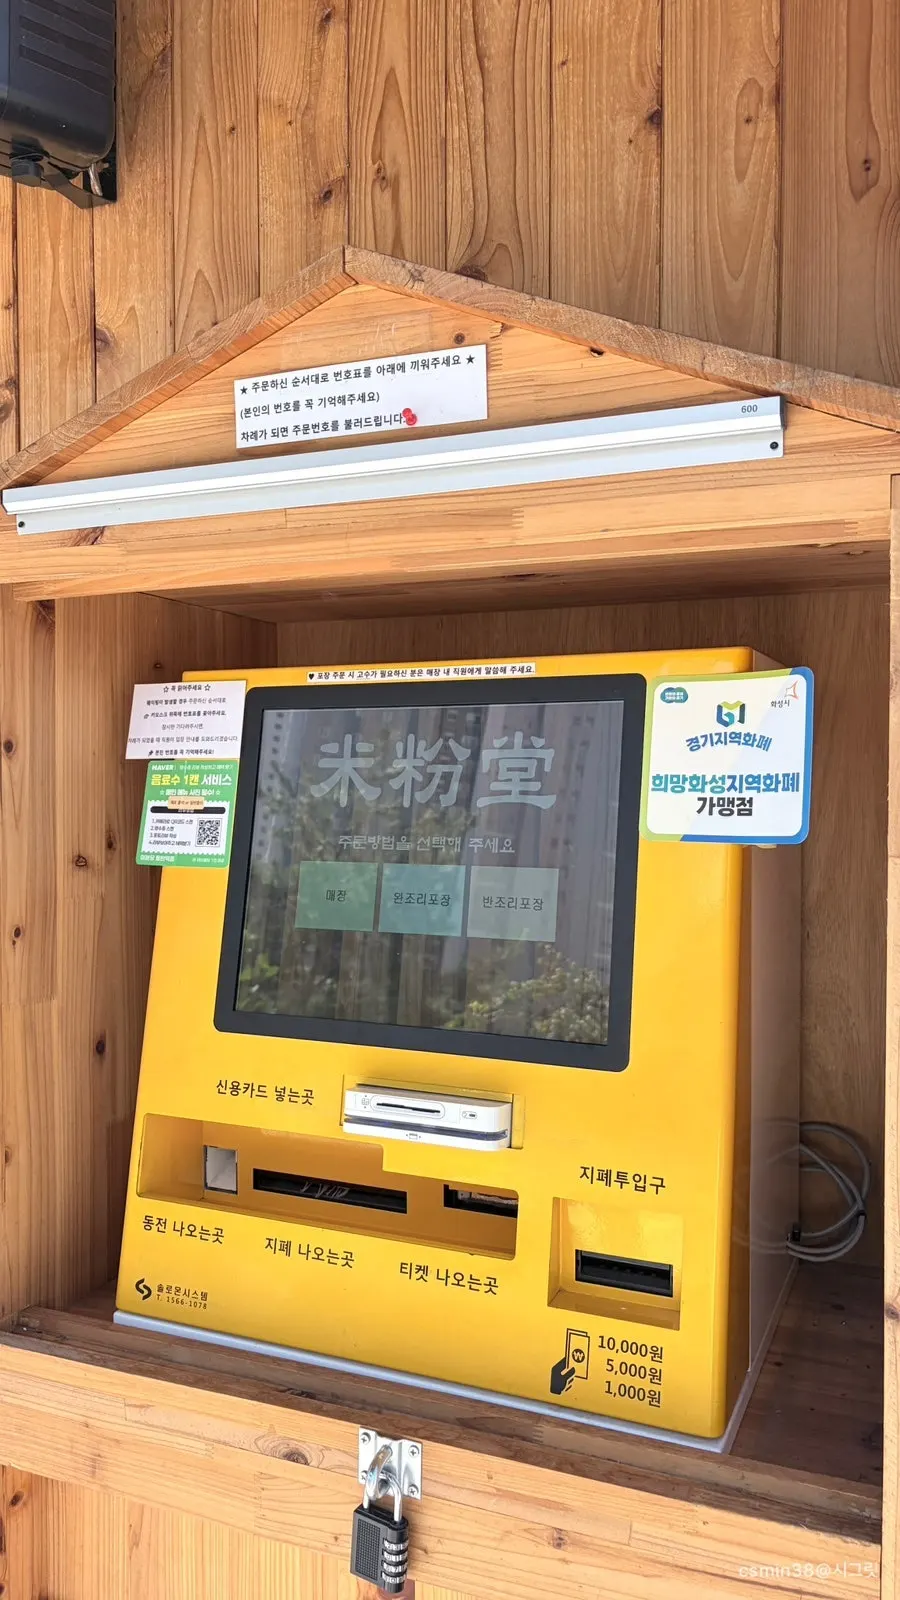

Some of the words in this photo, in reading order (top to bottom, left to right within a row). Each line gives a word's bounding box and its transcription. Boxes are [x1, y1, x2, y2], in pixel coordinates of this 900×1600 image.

[251, 377, 288, 393] 주문하신
[291, 372, 330, 387] 순서대로
[333, 366, 372, 382] 번호표를
[376, 361, 406, 377] 아래에
[409, 354, 462, 372] 끼워주세요
[240, 403, 271, 420] (본인의
[273, 399, 301, 415] 번호를
[304, 396, 314, 410] 꼭
[317, 391, 380, 409] 기억해주세요)
[741, 404, 758, 413] 600
[240, 428, 268, 443] 차례가
[270, 425, 289, 439] 되면
[292, 420, 340, 436] 주문번호를
[344, 412, 406, 430] 불러드립니다.
[317, 671, 331, 680] 포장
[332, 671, 346, 680] 주문
[347, 670, 355, 679] 시
[356, 670, 378, 679] 고수가
[379, 669, 407, 678] 필요하신
[409, 668, 423, 678] 분은
[426, 667, 441, 677] 매장
[443, 667, 450, 676] 내
[453, 666, 482, 676] 직원에게
[484, 665, 507, 675] 말씀해
[509, 664, 535, 674] 주세요.
[770, 699, 790, 708] 화성시
[686, 731, 773, 752] 경기지역화폐
[151, 774, 181, 786] 음료수
[183, 773, 200, 786] 1캔
[200, 773, 232, 786] 서비스
[310, 731, 557, 810] 米粉堂
[651, 772, 800, 794] 희망화성지역화폐
[696, 796, 754, 817] 가맹점
[338, 835, 412, 852] 주문방법을
[416, 836, 462, 853] 선택해
[468, 837, 516, 854] 주세요
[325, 889, 347, 902] 매장
[393, 892, 451, 907] 완조리포장
[482, 895, 545, 911] 반조리포장
[215, 1078, 269, 1100] 신용카드
[274, 1084, 315, 1106] 넣는곳
[579, 1165, 667, 1195] 지폐투입구
[142, 1214, 168, 1235] 동전
[172, 1221, 225, 1245] 나오는곳
[264, 1236, 292, 1258] 지폐
[297, 1243, 355, 1269] 나오는곳
[399, 1261, 430, 1283] 티켓
[436, 1267, 499, 1296] 나오는곳
[166, 1296, 207, 1309] 1566-1078
[597, 1335, 664, 1364] 10,000원
[605, 1359, 662, 1386] 5,000원
[604, 1380, 661, 1408] 1,000원
